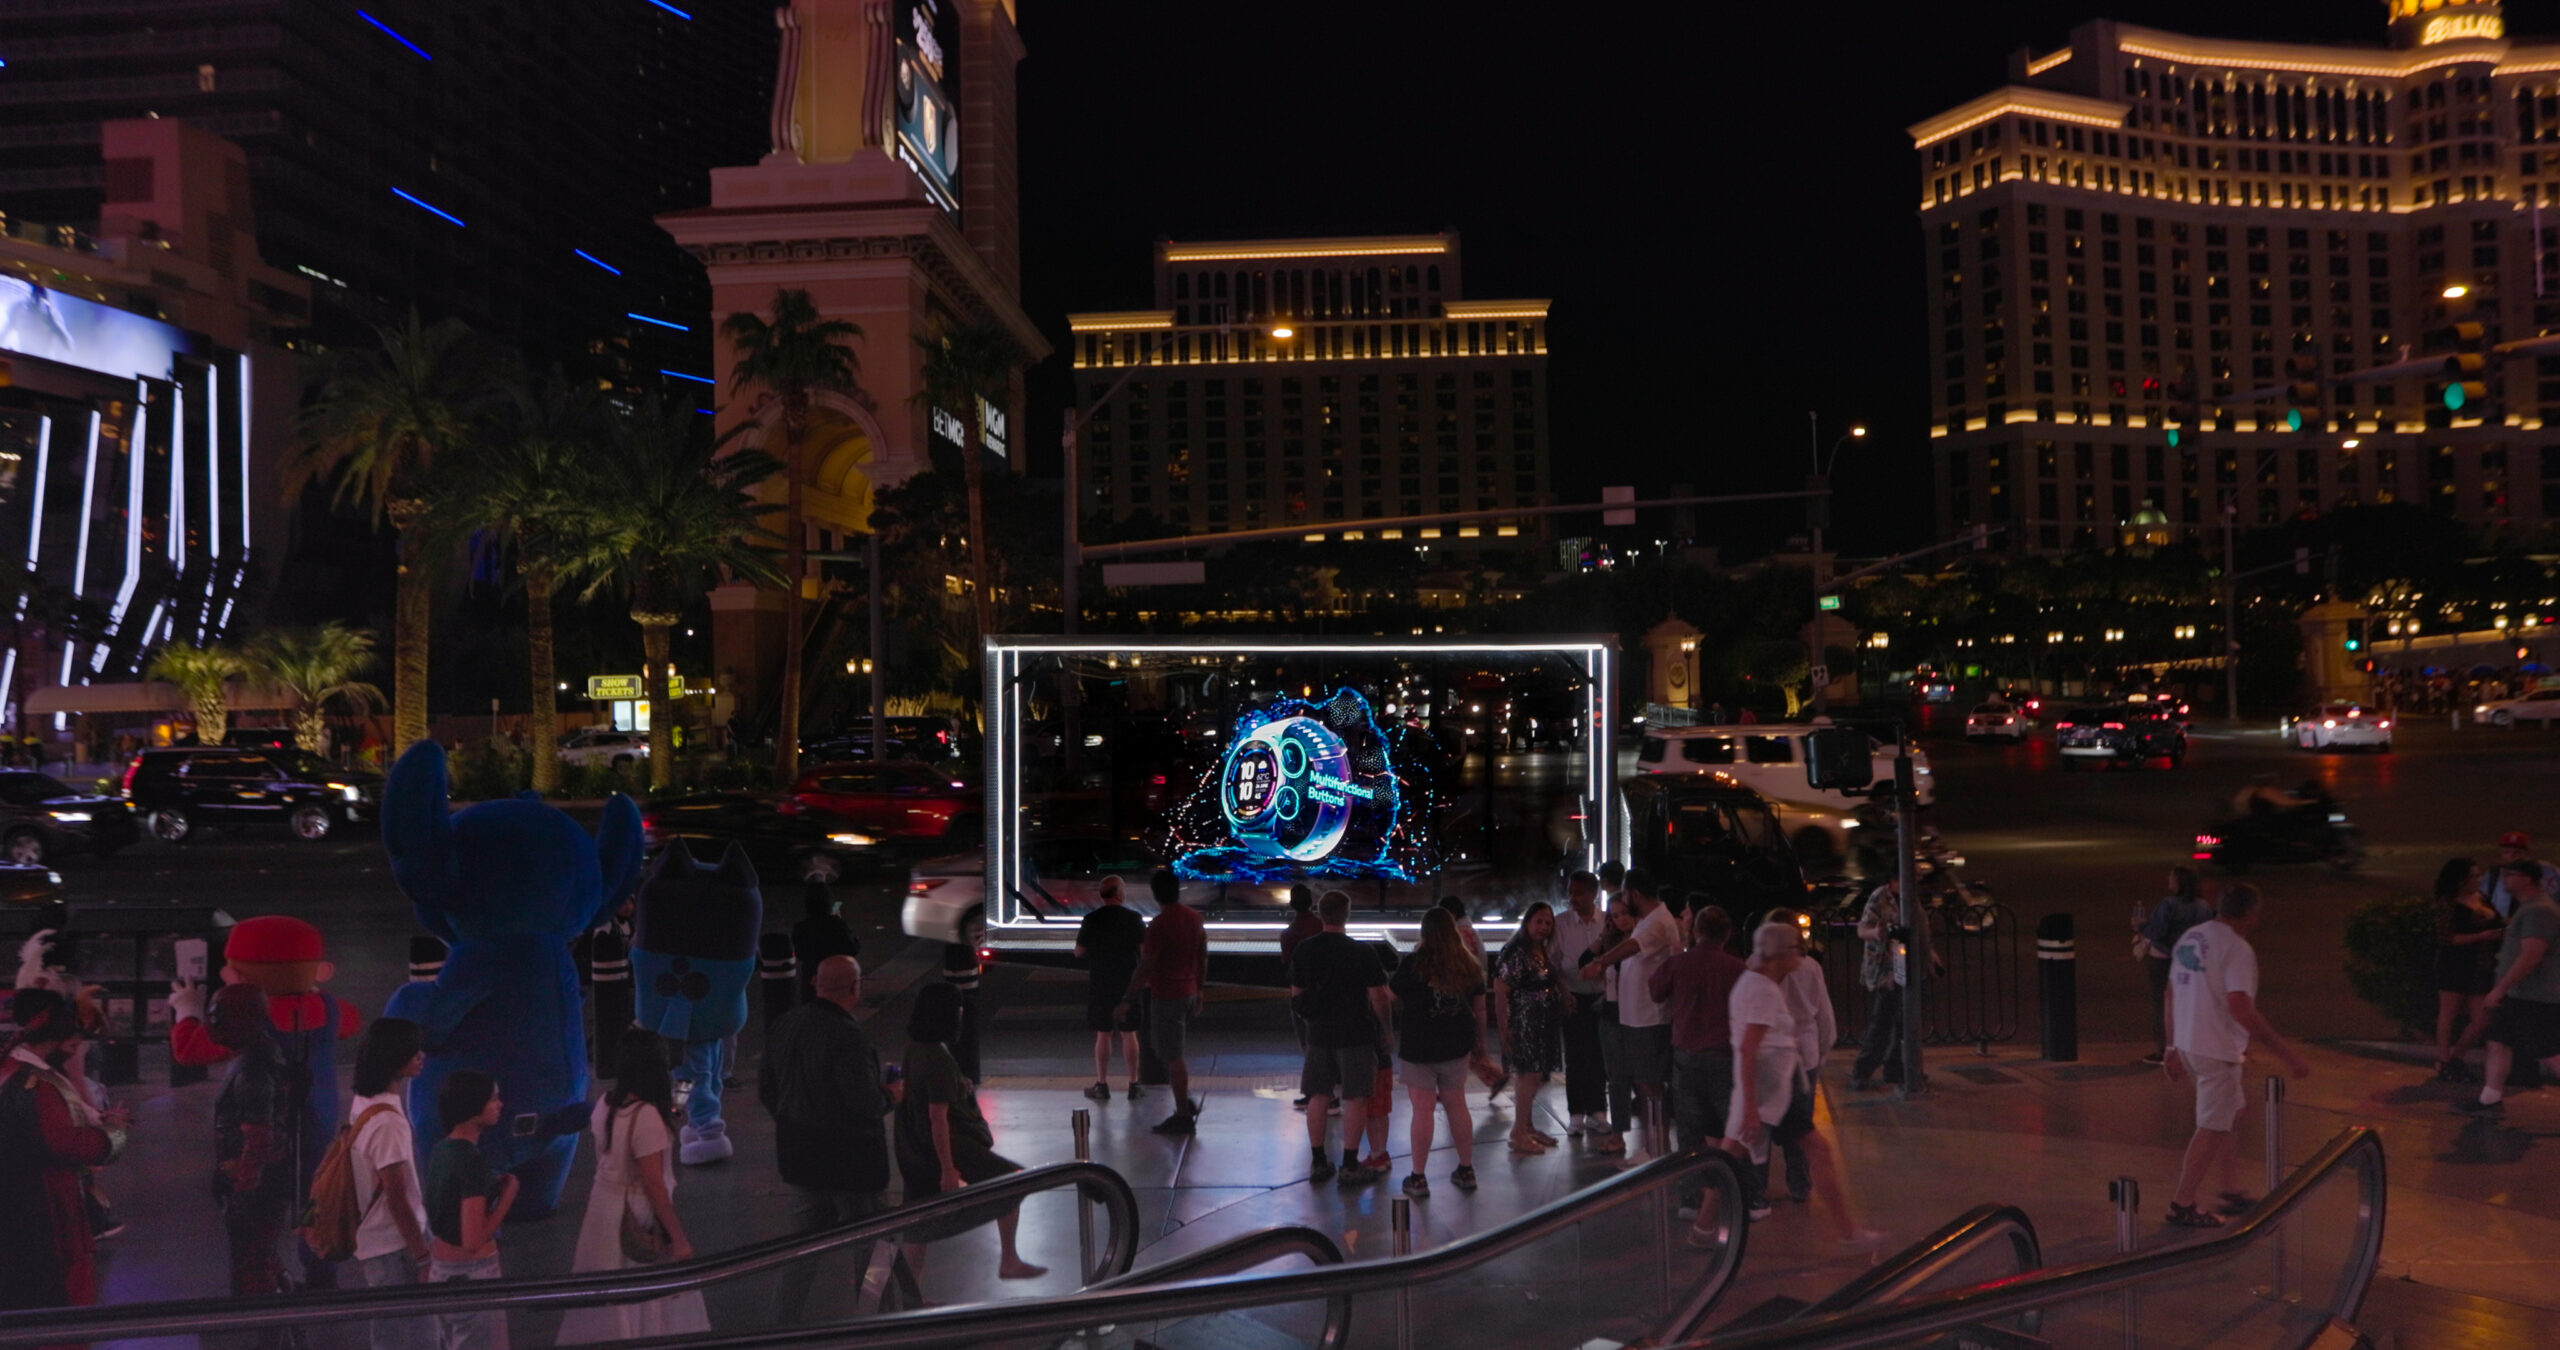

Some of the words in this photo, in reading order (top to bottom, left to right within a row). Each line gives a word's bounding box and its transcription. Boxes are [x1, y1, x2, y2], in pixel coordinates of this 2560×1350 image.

[986, 401, 1005, 440] MGM
[596, 687, 635, 696] TICKETS
[601, 679, 629, 687] SHOW
[1240, 761, 1255, 780] 10
[1239, 781, 1253, 801] 10
[1309, 770, 1374, 800] Multifunctional
[1308, 786, 1345, 807] Buttons
